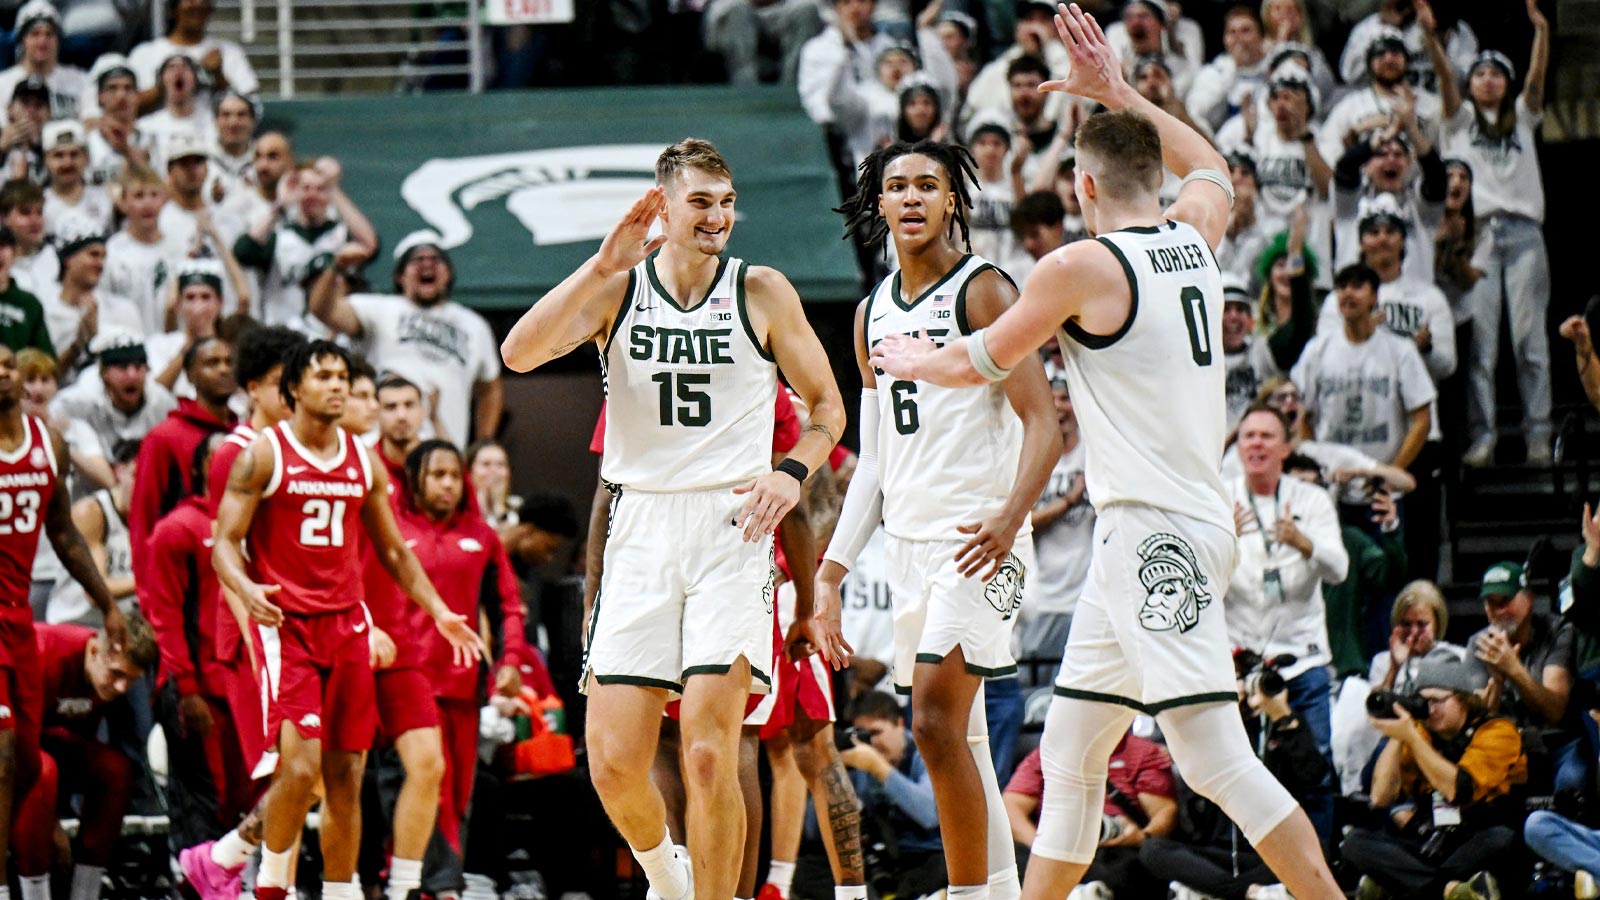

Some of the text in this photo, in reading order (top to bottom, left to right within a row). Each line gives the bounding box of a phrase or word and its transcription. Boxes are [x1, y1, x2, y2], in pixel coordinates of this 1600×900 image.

[1145, 244, 1208, 273] KOHLER
[629, 324, 735, 364] STATE
[1180, 285, 1212, 367] 0
[651, 372, 711, 427] 15
[890, 380, 920, 435] 6
[286, 480, 364, 498] ARKANSAS
[300, 499, 347, 547] 21
